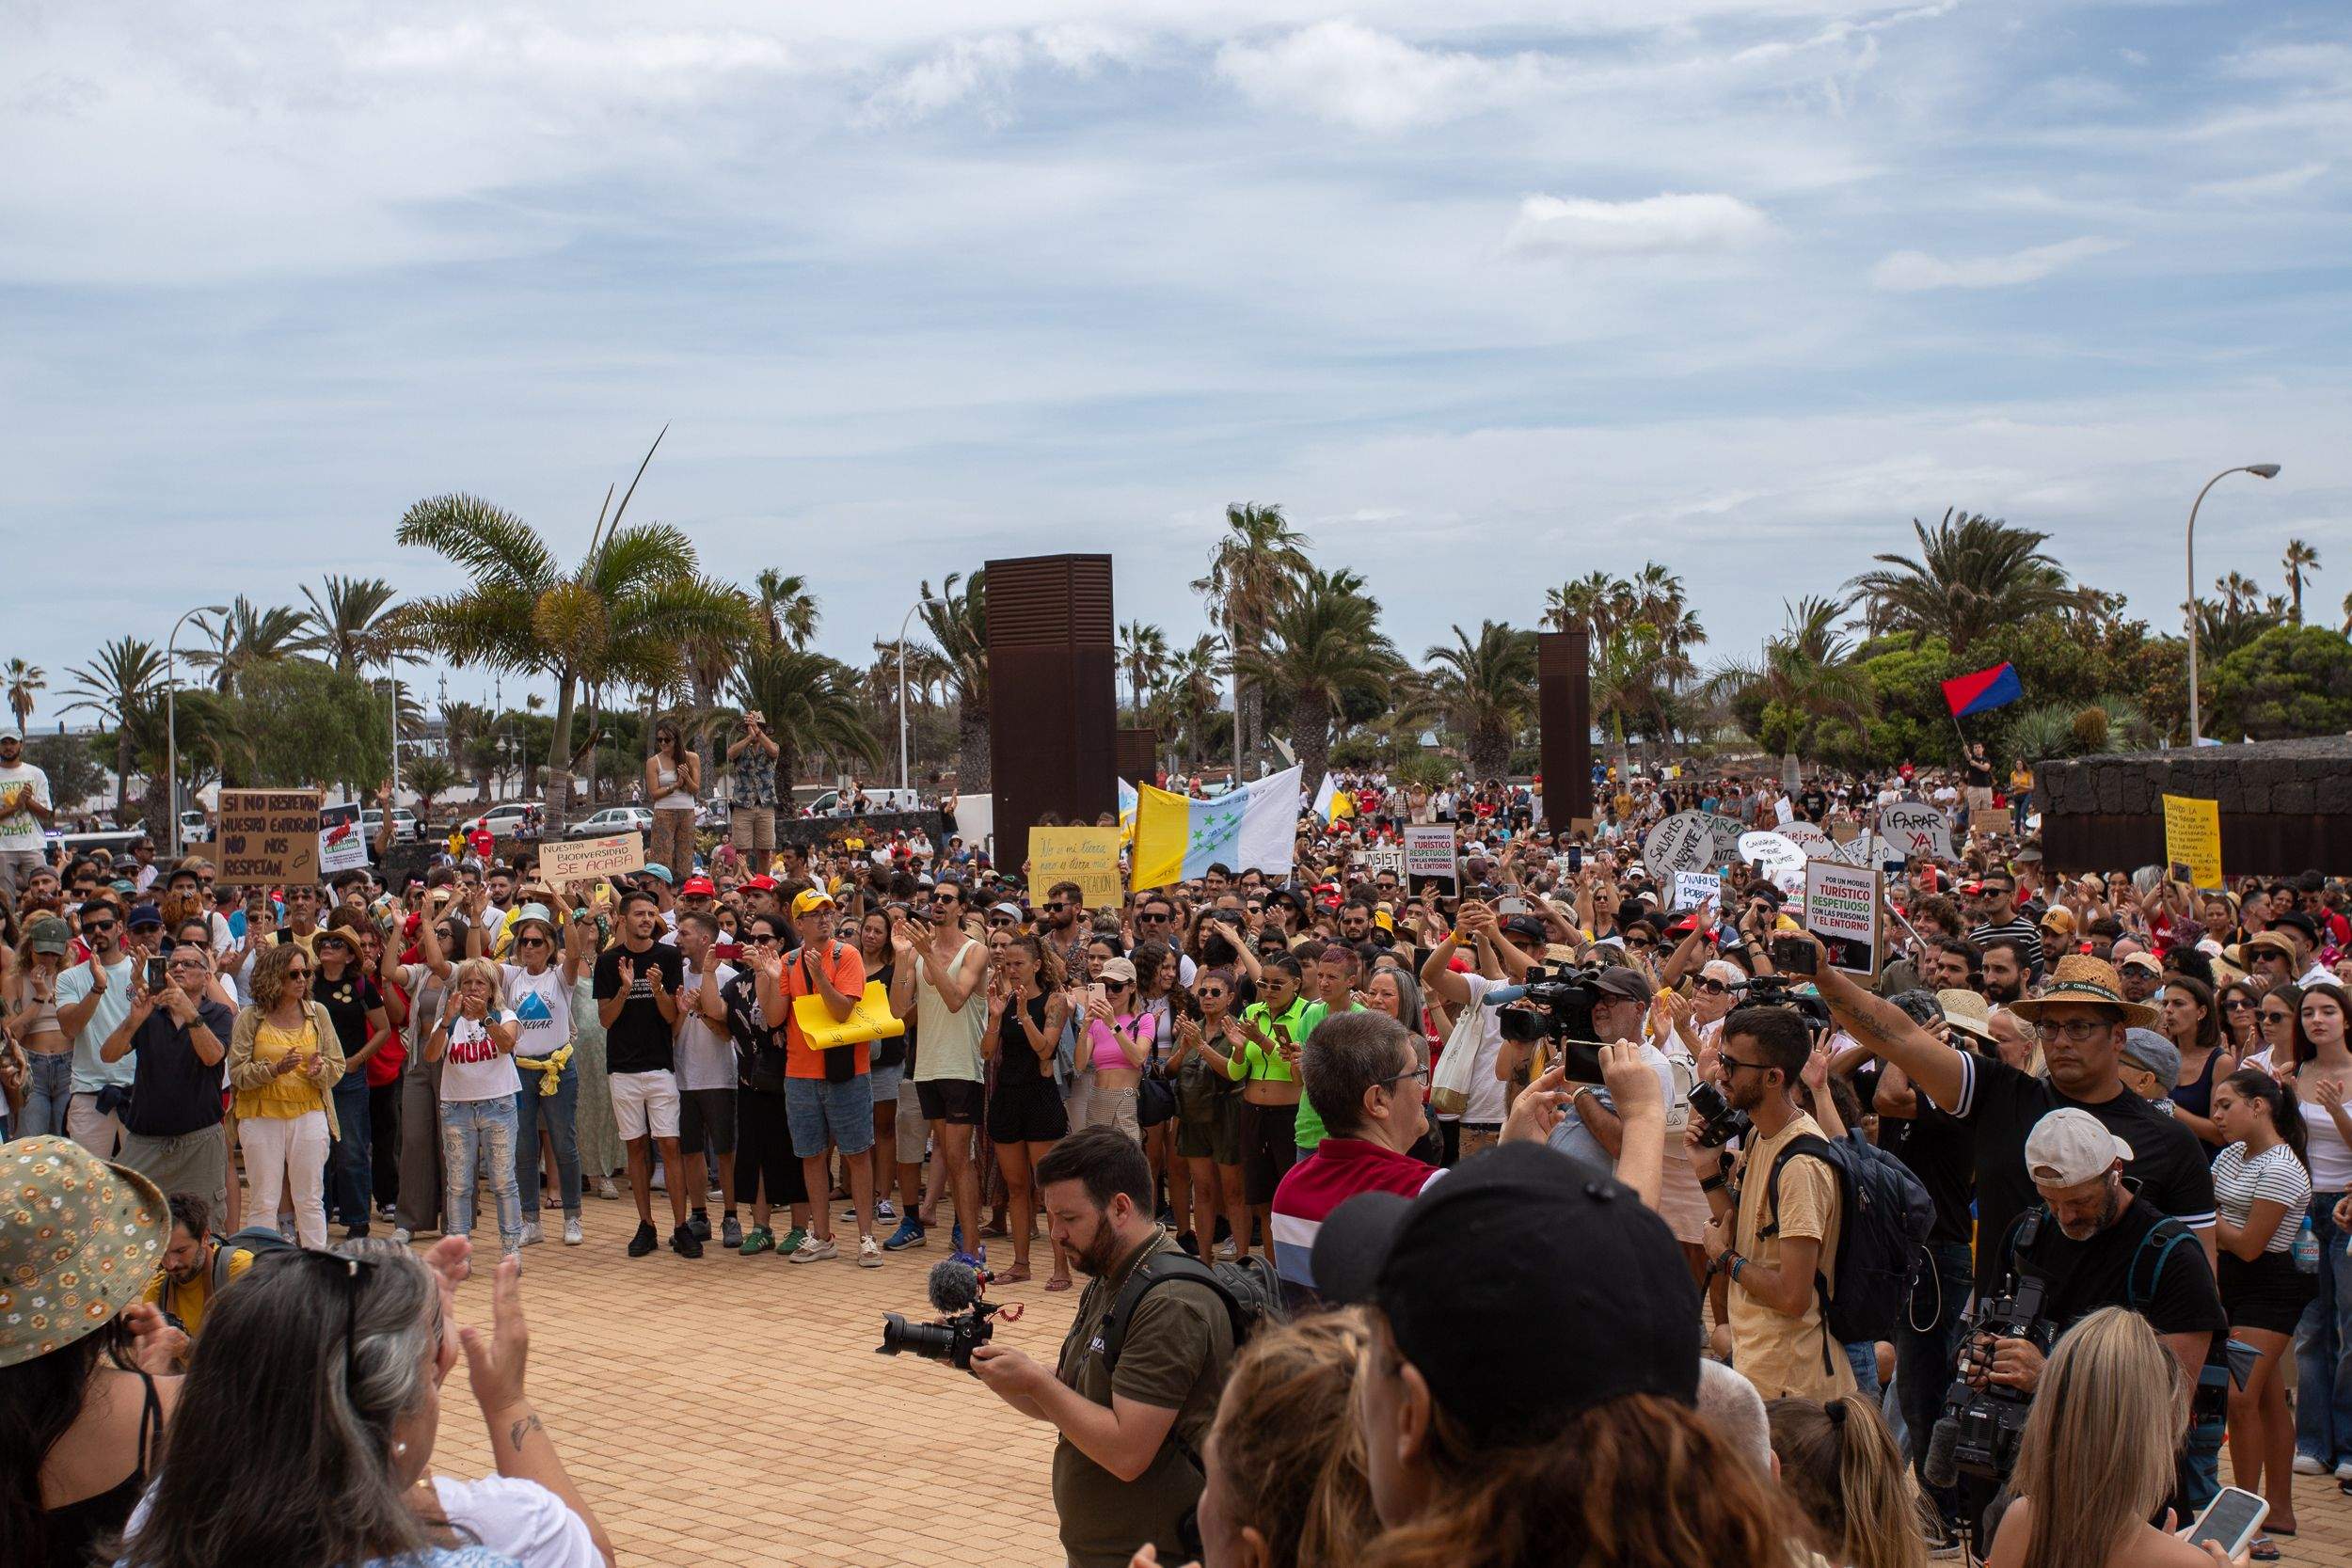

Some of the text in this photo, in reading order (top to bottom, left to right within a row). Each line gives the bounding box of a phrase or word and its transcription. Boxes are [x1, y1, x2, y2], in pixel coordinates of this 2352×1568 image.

[244, 796, 265, 812] NO
[269, 795, 319, 812] RESPETAN
[220, 816, 266, 833] NUESTRO
[225, 835, 289, 855] NO NOS
[543, 843, 584, 855] NUESTRA
[1906, 832, 1938, 852] YA!
[557, 847, 628, 862] BIODIVERSIDAD
[555, 853, 633, 876] SE ACABA
[1847, 879, 1870, 888] MODELO
[1683, 887, 1720, 900] POBREA
[1820, 884, 1870, 901] TURÍSTICO
[1812, 895, 1870, 912] RESPETUOSO
[1813, 915, 1869, 931] Y EL ENTORNO
[1824, 909, 1836, 917] LAS
[1836, 911, 1870, 922] PERSONAS
[2088, 985, 2104, 994] RURAL
[521, 1020, 553, 1030] ALVAR
[450, 1037, 498, 1065] MUA!
